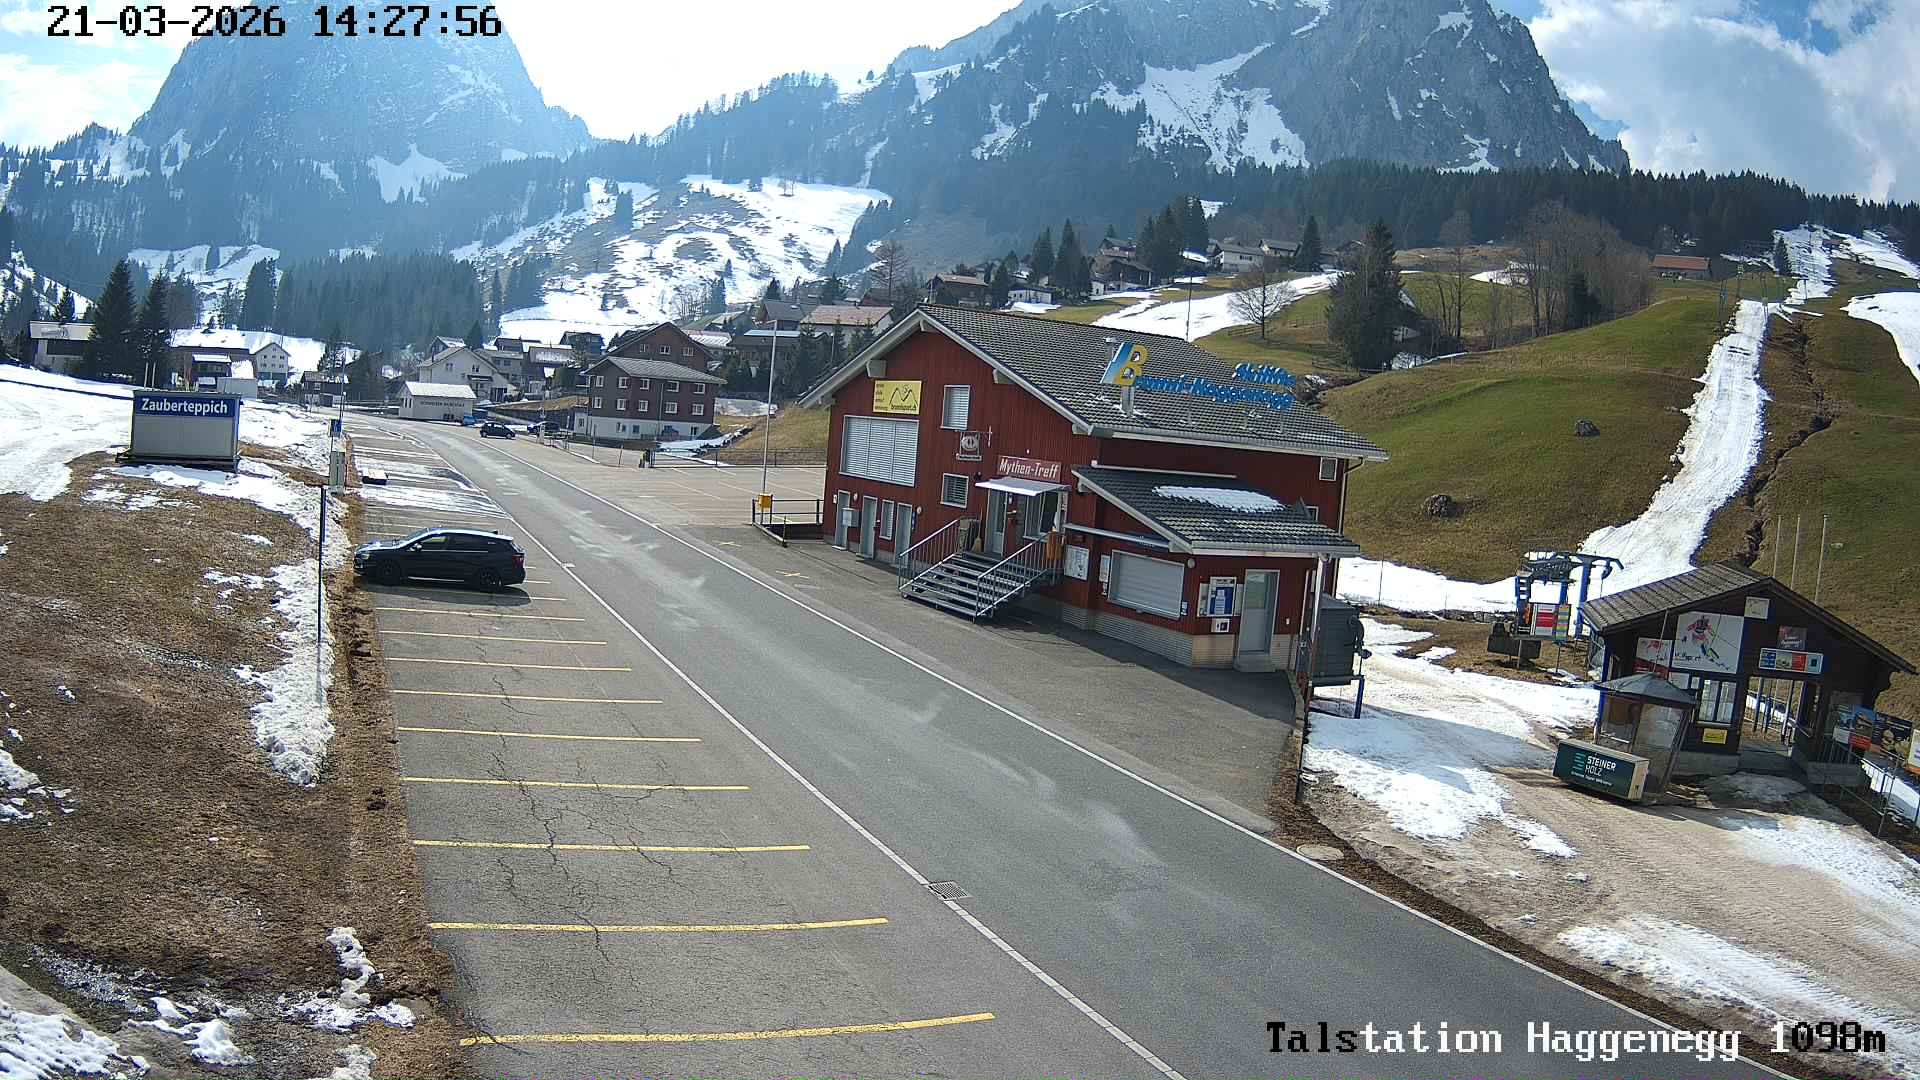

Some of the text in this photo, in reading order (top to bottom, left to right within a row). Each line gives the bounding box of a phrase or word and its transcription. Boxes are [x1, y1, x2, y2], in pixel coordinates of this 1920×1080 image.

[140, 396, 229, 416] Zauberteppich
[999, 458, 1059, 479] Mythen-Treff
[1584, 764, 1604, 777] HOLZ
[1586, 755, 1617, 772] STEINER
